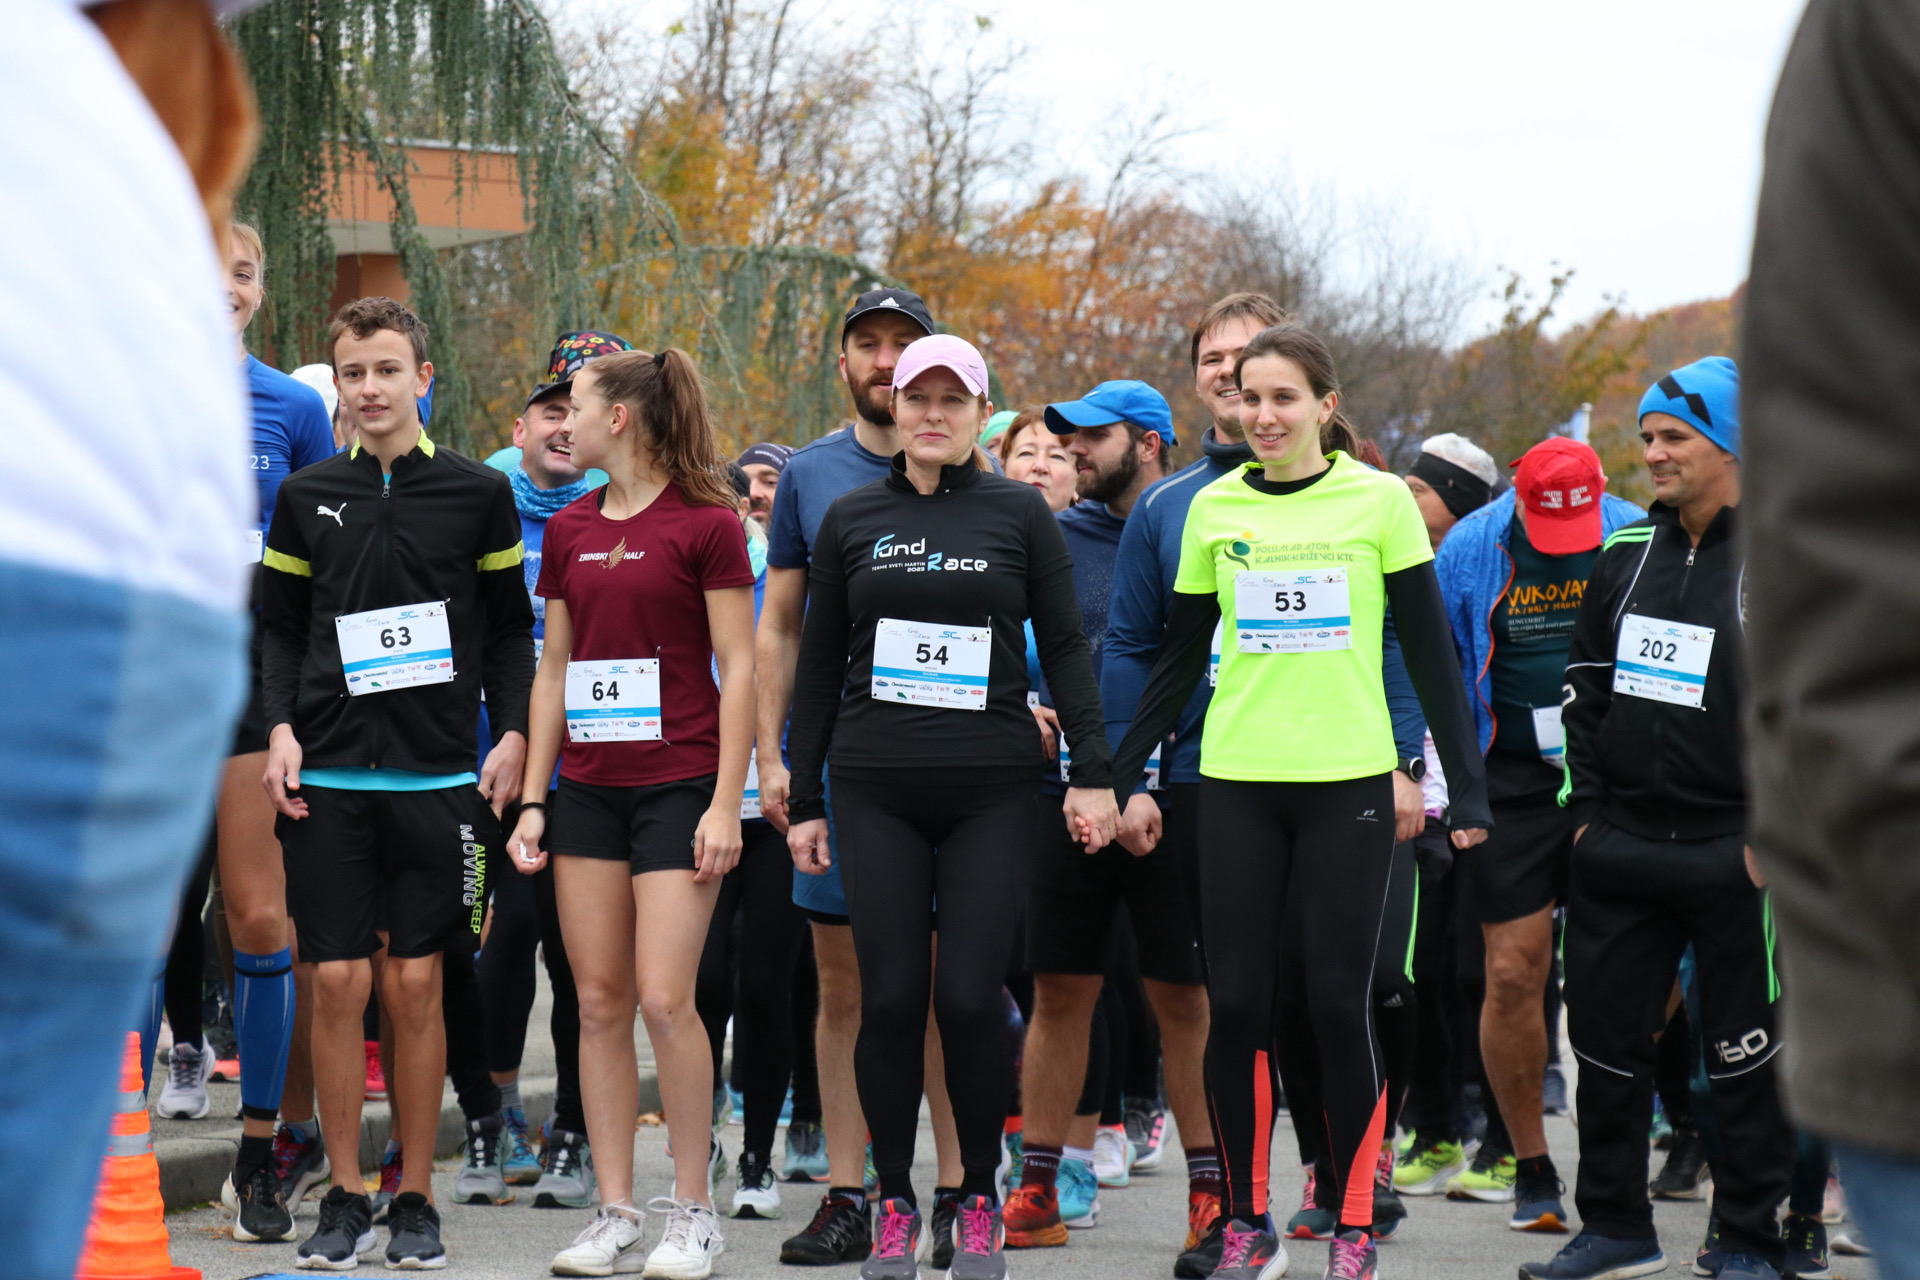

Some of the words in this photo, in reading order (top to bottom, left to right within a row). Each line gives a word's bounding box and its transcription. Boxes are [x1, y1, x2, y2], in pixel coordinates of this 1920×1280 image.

[578, 552, 609, 562] ZRINSKI
[623, 551, 646, 560] HALF
[1255, 542, 1330, 554] POLUMARATON
[1337, 553, 1354, 562] KTC
[872, 564, 888, 572] TERME
[1275, 590, 1307, 612] 53
[380, 626, 412, 649] 63
[915, 642, 949, 666] 54
[1639, 638, 1678, 662] 202
[592, 680, 620, 702] 64
[460, 824, 477, 907] MOVING
[474, 843, 486, 898] ALWAYS
[470, 901, 483, 934] KEEP
